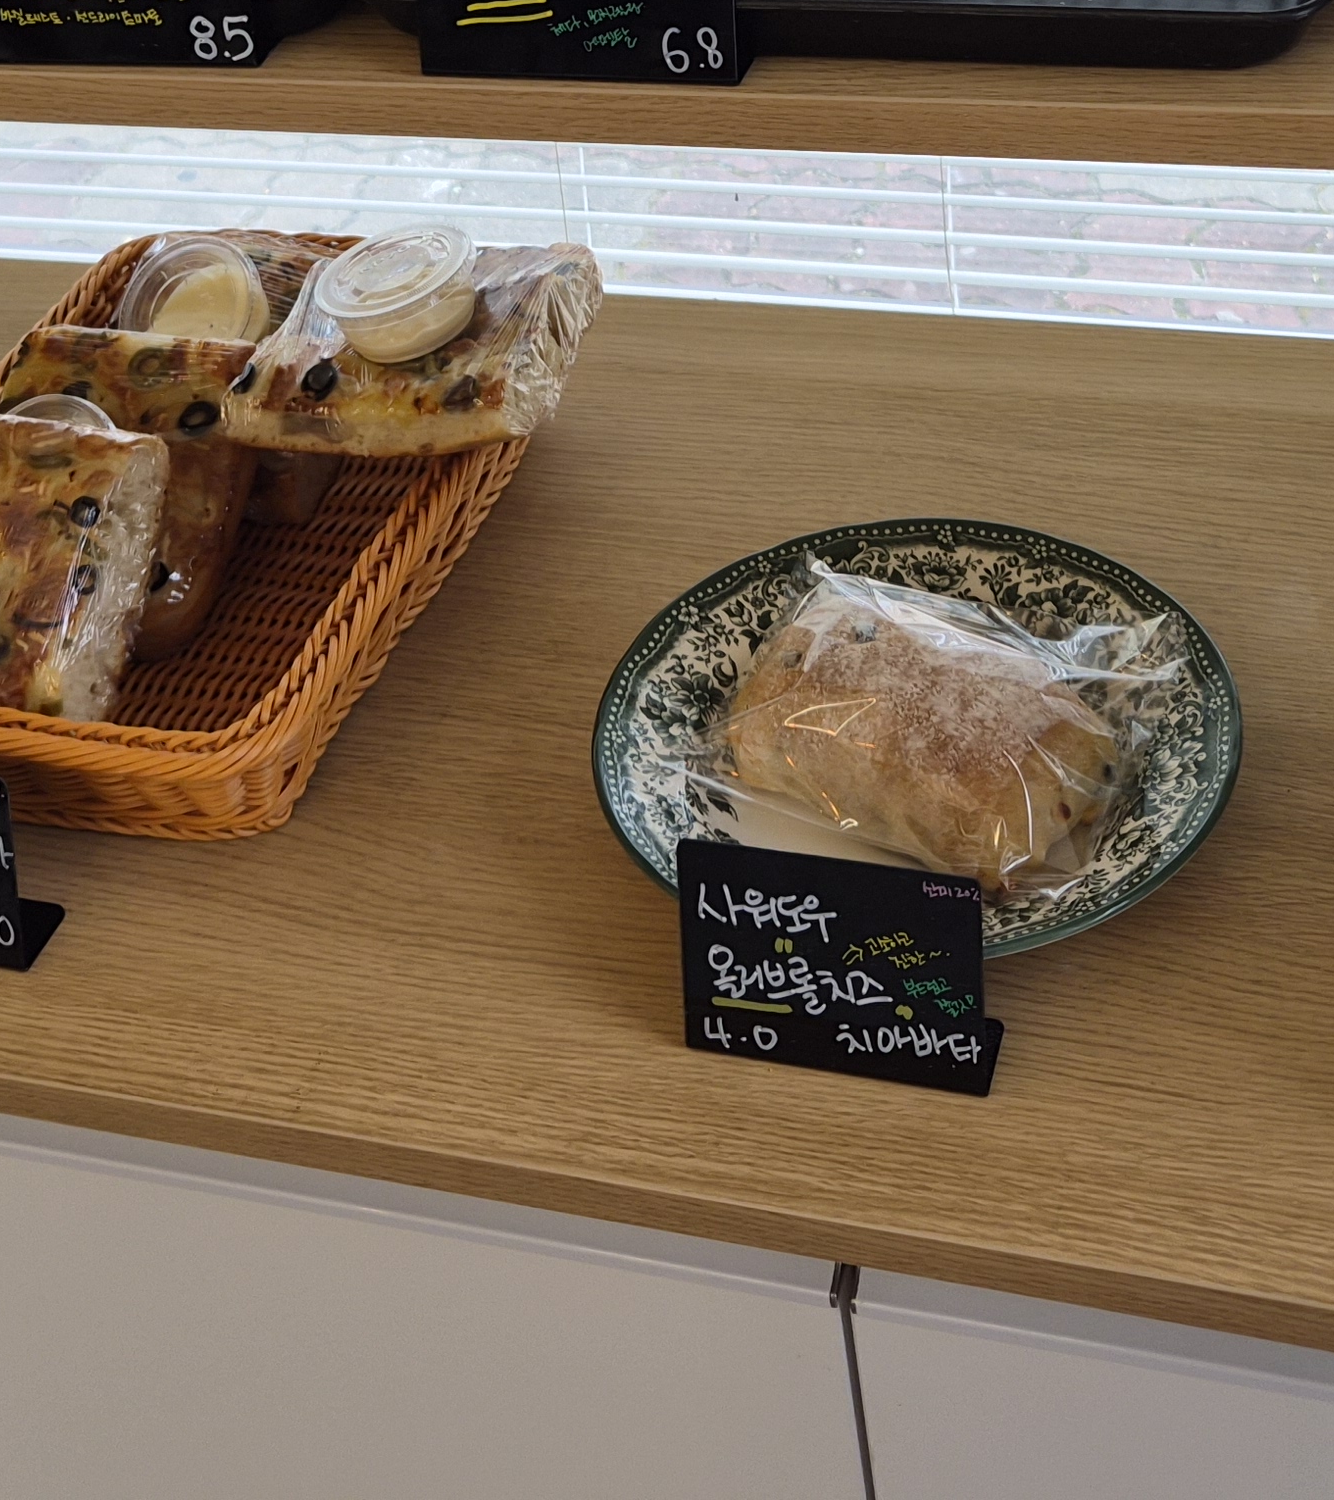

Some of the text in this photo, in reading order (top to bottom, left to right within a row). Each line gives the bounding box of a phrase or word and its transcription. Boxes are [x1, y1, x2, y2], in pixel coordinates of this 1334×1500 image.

[188, 14, 255, 62] 8.5
[661, 25, 725, 75] 6.8
[697, 882, 838, 943] 사워도우
[703, 1016, 778, 1051] 4.0
[836, 1023, 982, 1064] 치아바타
